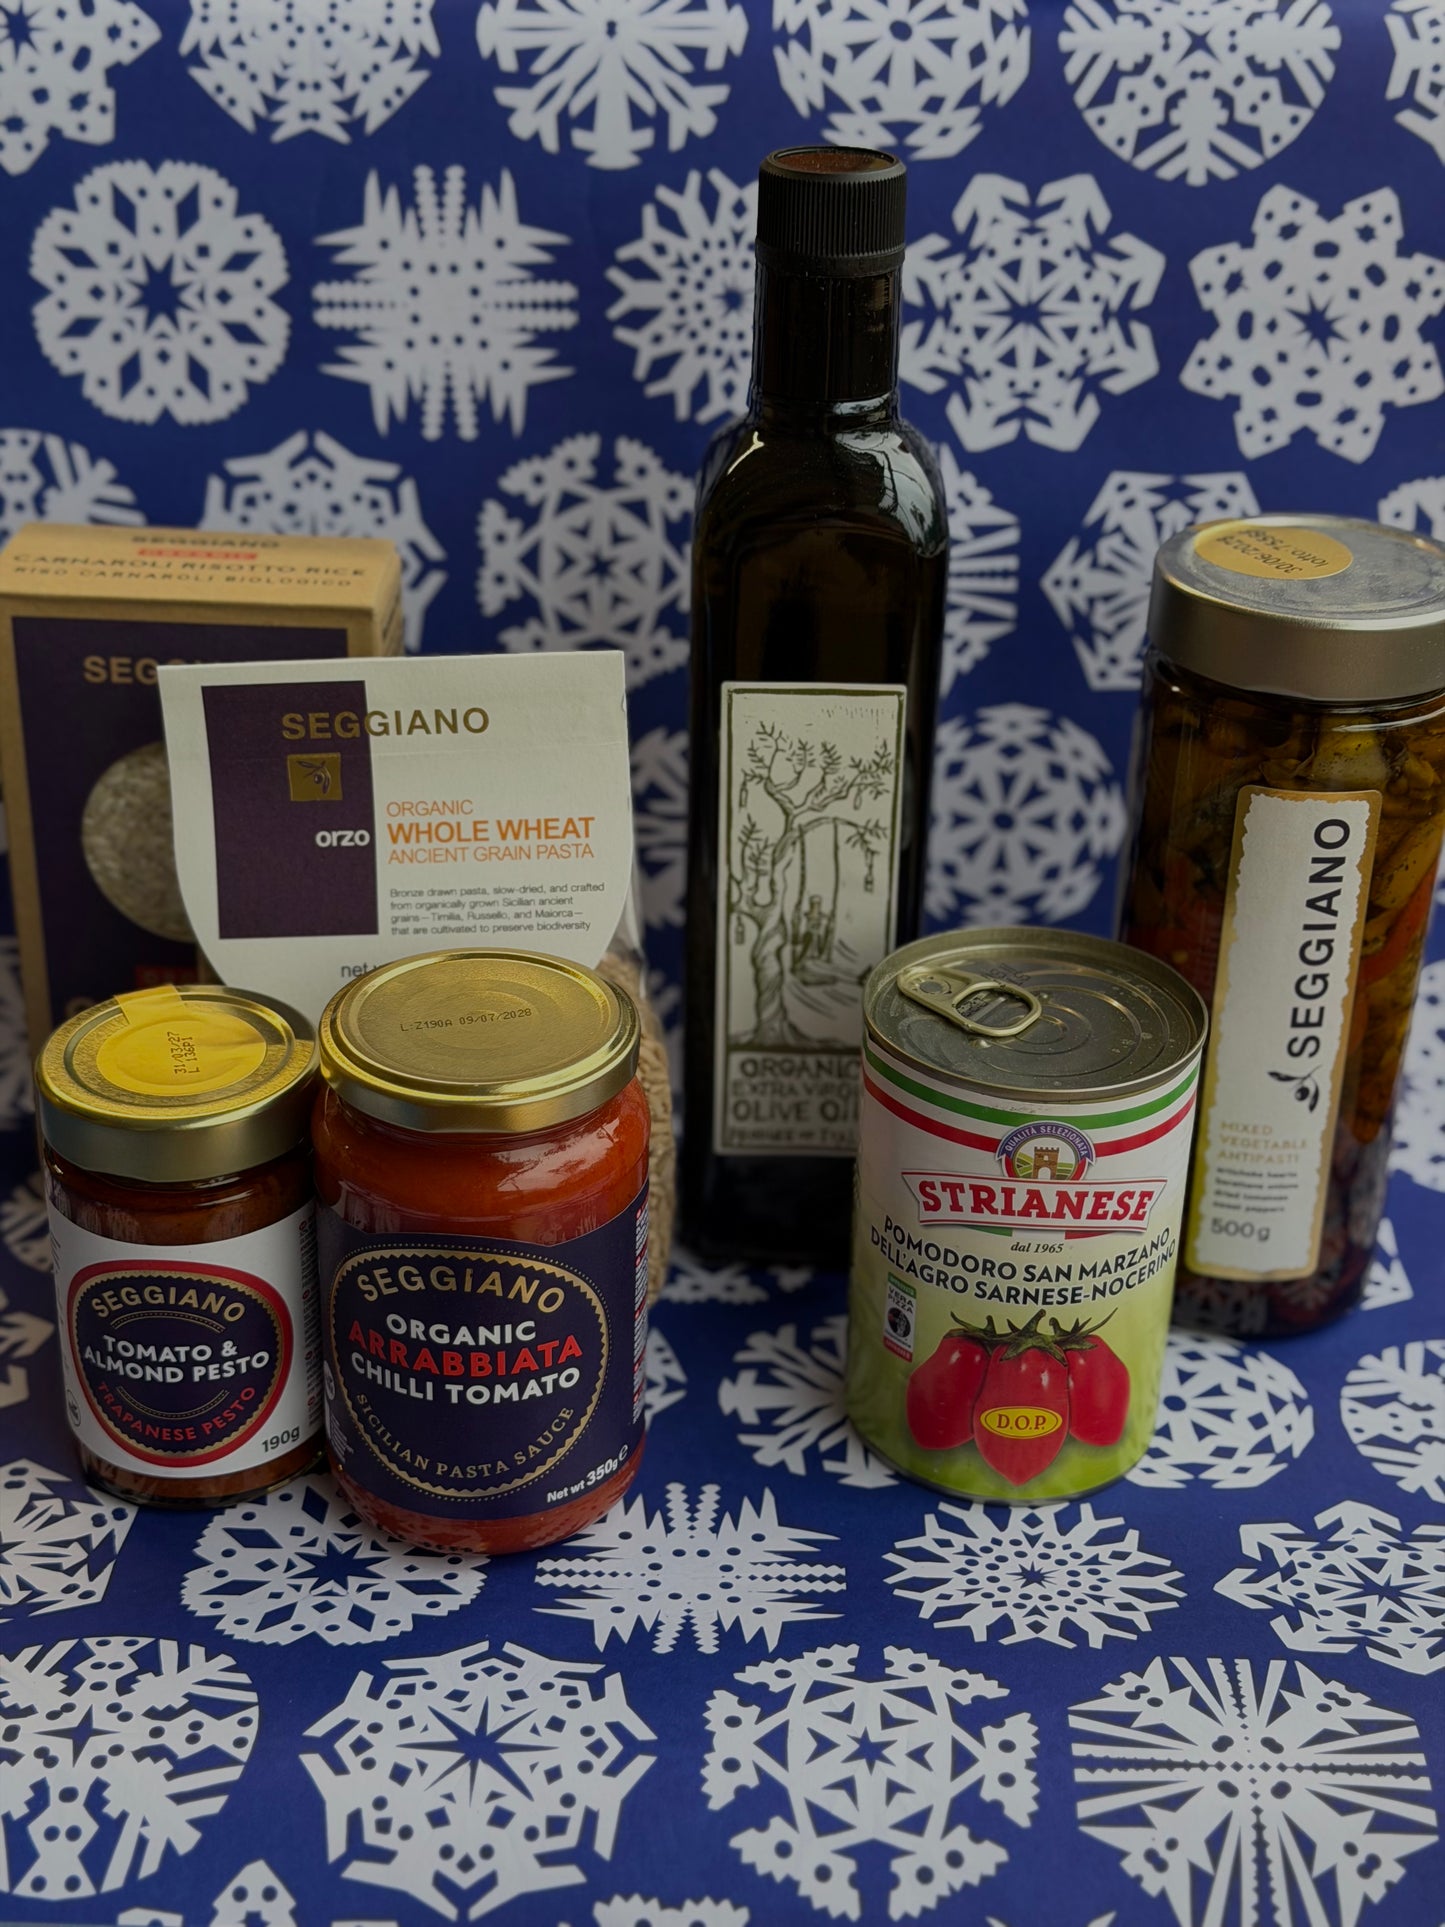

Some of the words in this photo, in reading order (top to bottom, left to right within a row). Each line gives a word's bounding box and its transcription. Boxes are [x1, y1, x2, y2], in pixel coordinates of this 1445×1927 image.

[181, 563, 297, 573] RISOTTO
[305, 566, 366, 576] RICE
[281, 707, 490, 740] SEGGIANO
[386, 799, 474, 818] ORGANIC
[315, 829, 370, 848] orzo
[387, 820, 490, 845] WHOLE
[496, 816, 596, 841] WHEAT
[388, 847, 469, 864] ANCIENT
[473, 845, 532, 863] GRAIN
[537, 843, 595, 860] PASTA
[390, 888, 424, 898] Bronze
[427, 887, 457, 897] drawn
[460, 887, 490, 897] pasta,
[493, 884, 546, 895] slow-dried,
[550, 883, 568, 893] and
[570, 882, 605, 892] crafted
[390, 901, 412, 910] from
[415, 900, 466, 911] organically
[469, 900, 499, 910] grown
[502, 897, 535, 907] Sicilian
[538, 896, 573, 906] ancient
[514, 910, 532, 919] and
[391, 926, 409, 935] that
[413, 926, 428, 935] are
[431, 925, 477, 935] cultivated
[479, 925, 490, 933] to
[492, 923, 534, 934] preserve
[537, 921, 591, 931] biodiversity
[1286, 817, 1351, 1058] SEGGIANO
[340, 961, 368, 978] net
[459, 1008, 532, 1025] 09/07/2028
[167, 1031, 187, 1074] 31/03/27
[740, 1057, 862, 1078] ORGANIC
[732, 1080, 800, 1097] EXTRA
[802, 1080, 859, 1100] VIRGI
[733, 1100, 813, 1123] OLIVE
[1220, 1121, 1273, 1135] MIXED
[1004, 1126, 1037, 1151] QUALITÀ
[1039, 1125, 1088, 1156] SELEZIONATA
[1219, 1134, 1307, 1150] VEGETABLE
[1218, 1150, 1299, 1164] ANTIPASTI
[918, 1180, 1155, 1221] STRIANESE
[884, 1215, 1017, 1280] POMODORO
[1022, 1264, 1072, 1283] SAN
[1078, 1227, 1170, 1281] MARZANO
[1010, 1241, 1031, 1253] dal
[1034, 1243, 1065, 1254] 1965
[871, 1225, 969, 1294] DELL'AGRO
[974, 1238, 1176, 1306] SARNESE-NOCERINO
[356, 1265, 565, 1313] SEGGIANO
[888, 1286, 914, 1308] VERA
[91, 1285, 246, 1322] SEGGIANO
[887, 1292, 913, 1314] PIZZA
[386, 1313, 537, 1347] ORGANIC
[103, 1335, 212, 1363] TOMATO
[221, 1340, 239, 1358] &
[348, 1320, 583, 1378] ARRABBIATA
[84, 1345, 184, 1383] ALMOND
[193, 1350, 270, 1382] PESTO
[350, 1352, 433, 1401] CHILLI
[445, 1367, 581, 1405] TOMATO
[97, 1381, 197, 1441] TRAPANESE
[201, 1386, 256, 1436] PESTO
[995, 1413, 1047, 1431] D.O.P.
[261, 1425, 300, 1453] 190g
[356, 1393, 431, 1470] SICILIAN
[436, 1459, 510, 1479] PASTA
[513, 1406, 574, 1465] SAUCE
[546, 1487, 569, 1503] Net
[570, 1480, 586, 1494] wt
[586, 1458, 618, 1486] 350g
